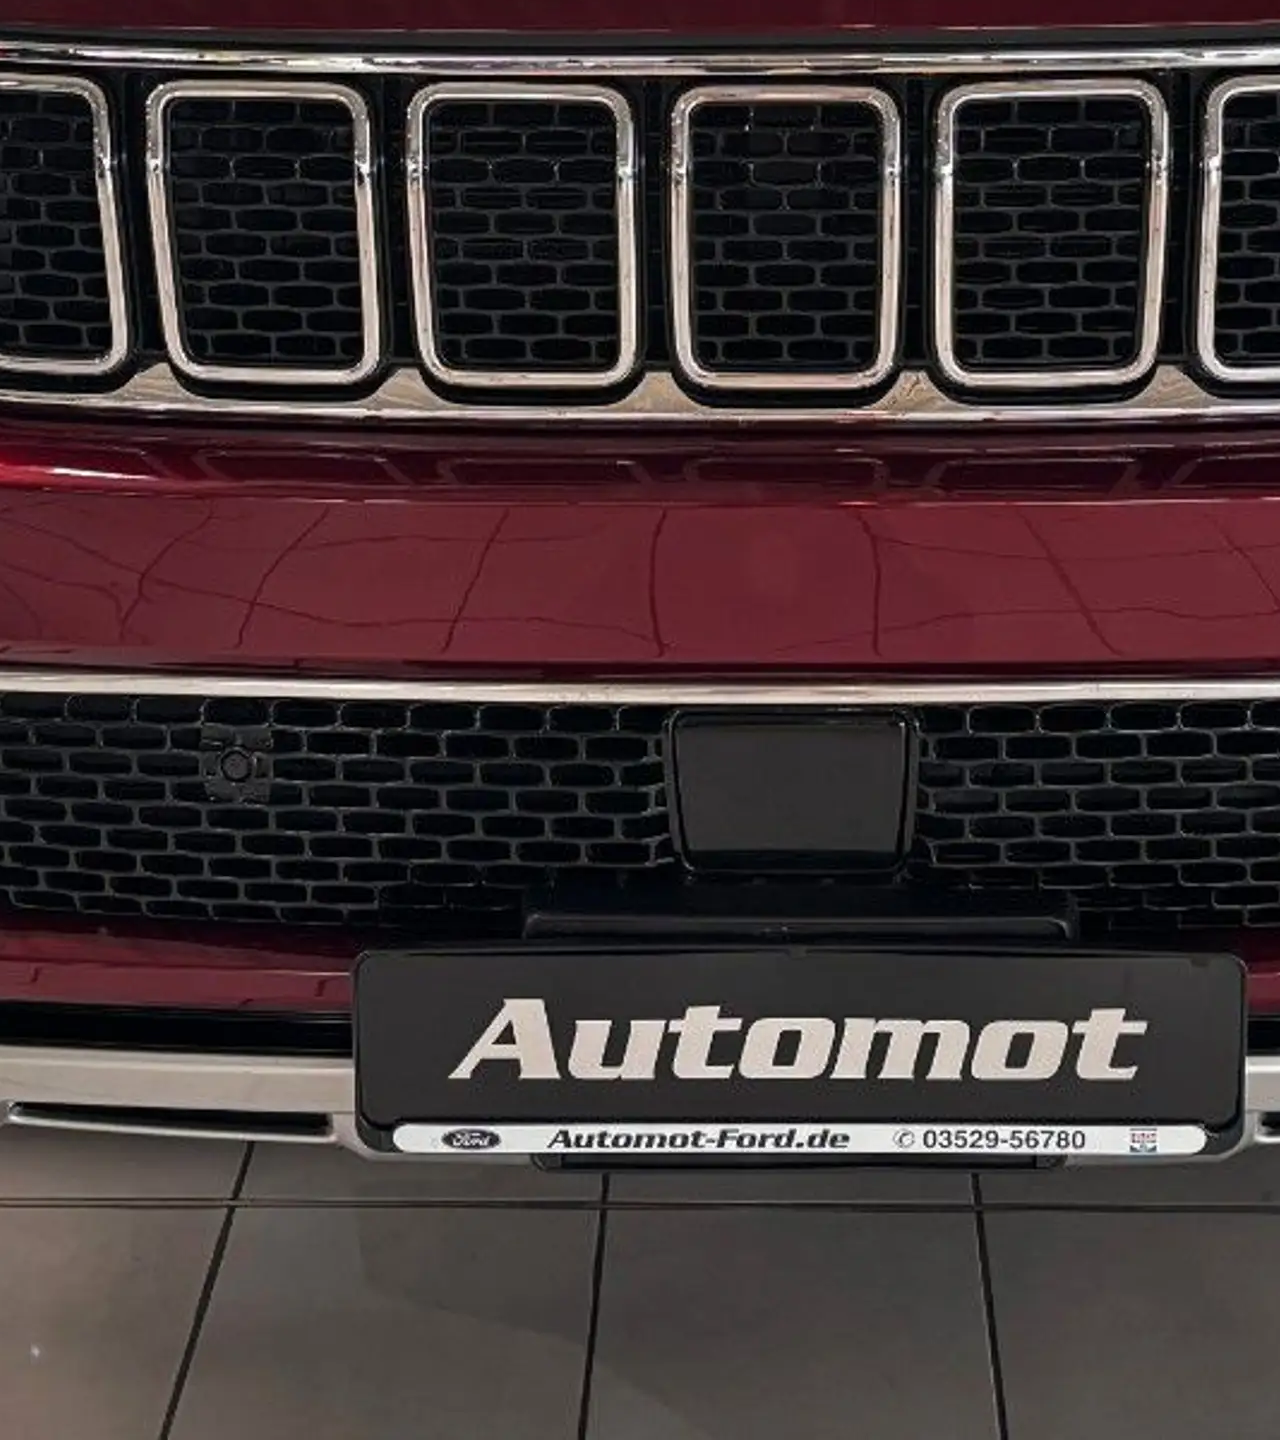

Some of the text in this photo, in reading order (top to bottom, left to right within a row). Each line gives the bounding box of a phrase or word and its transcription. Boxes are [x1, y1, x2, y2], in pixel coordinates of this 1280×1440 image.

[447, 998, 1148, 1081] Automot
[546, 1128, 850, 1149] Automot-Ford.de
[922, 1129, 1086, 1150] 03529-56780
